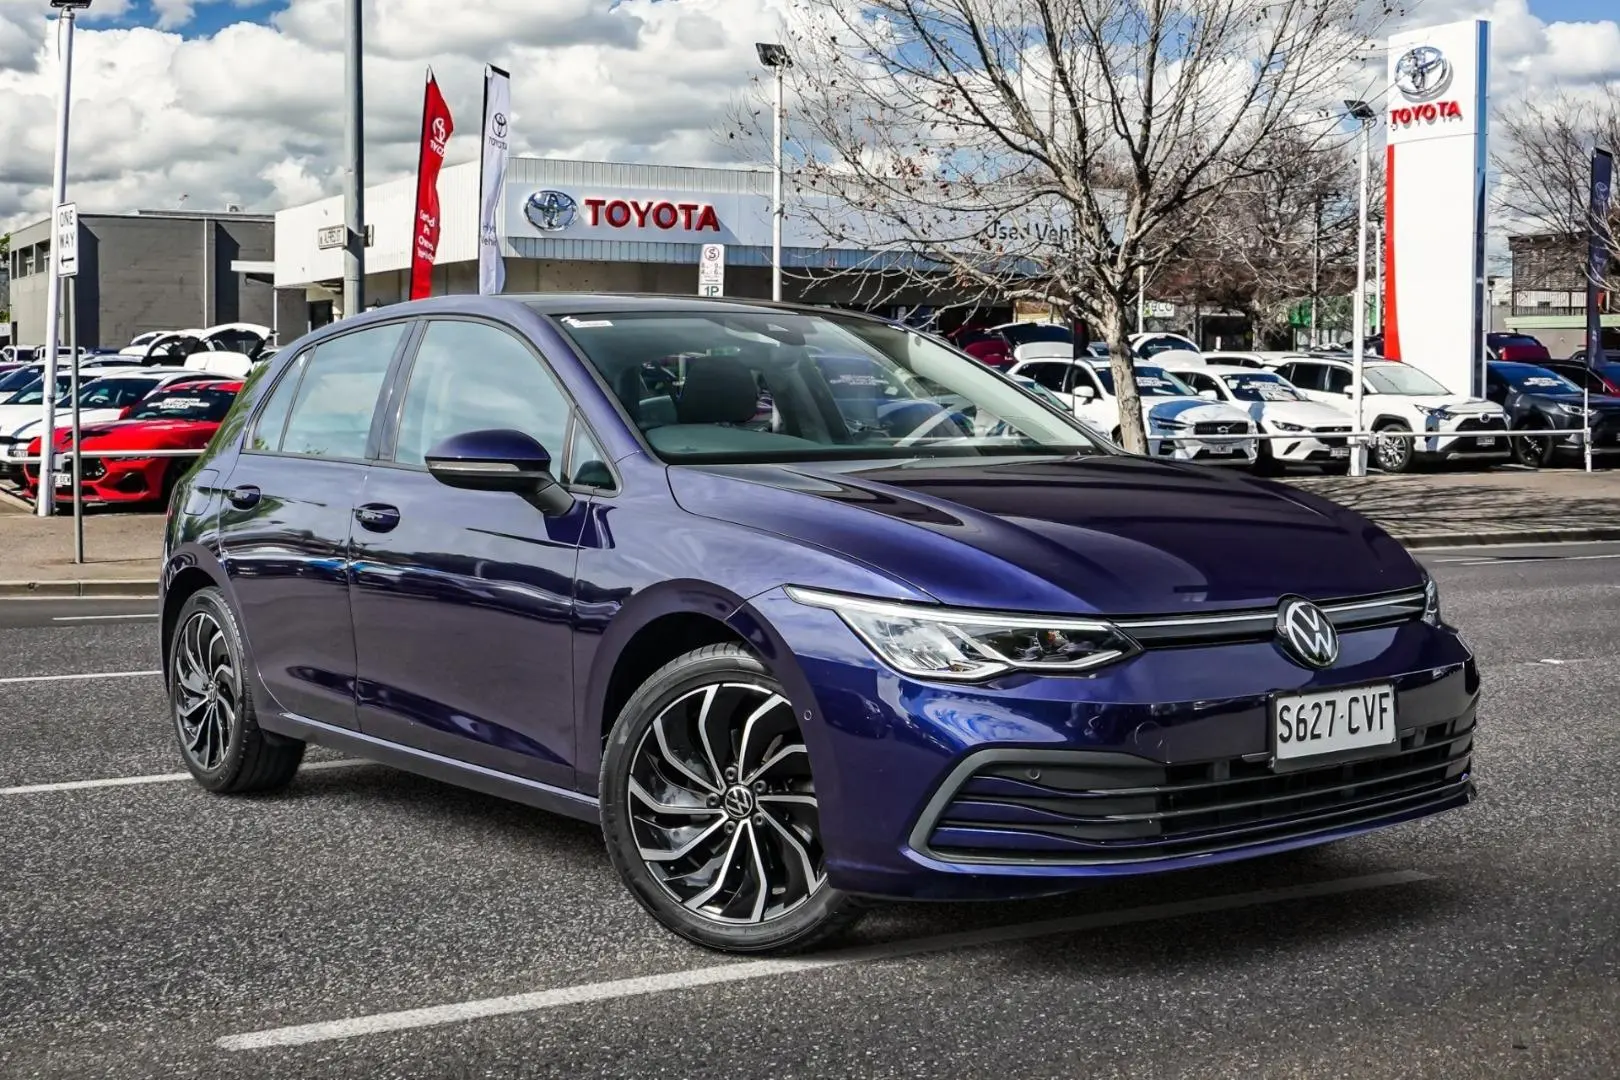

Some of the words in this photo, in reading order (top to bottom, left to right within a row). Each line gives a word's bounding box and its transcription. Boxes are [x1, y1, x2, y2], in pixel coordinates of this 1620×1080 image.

[1390, 101, 1462, 124] TOYOTA
[59, 209, 74, 228] ONE
[584, 199, 721, 232] TOYOTA
[59, 232, 75, 249] WAY
[704, 285, 719, 297] 1P
